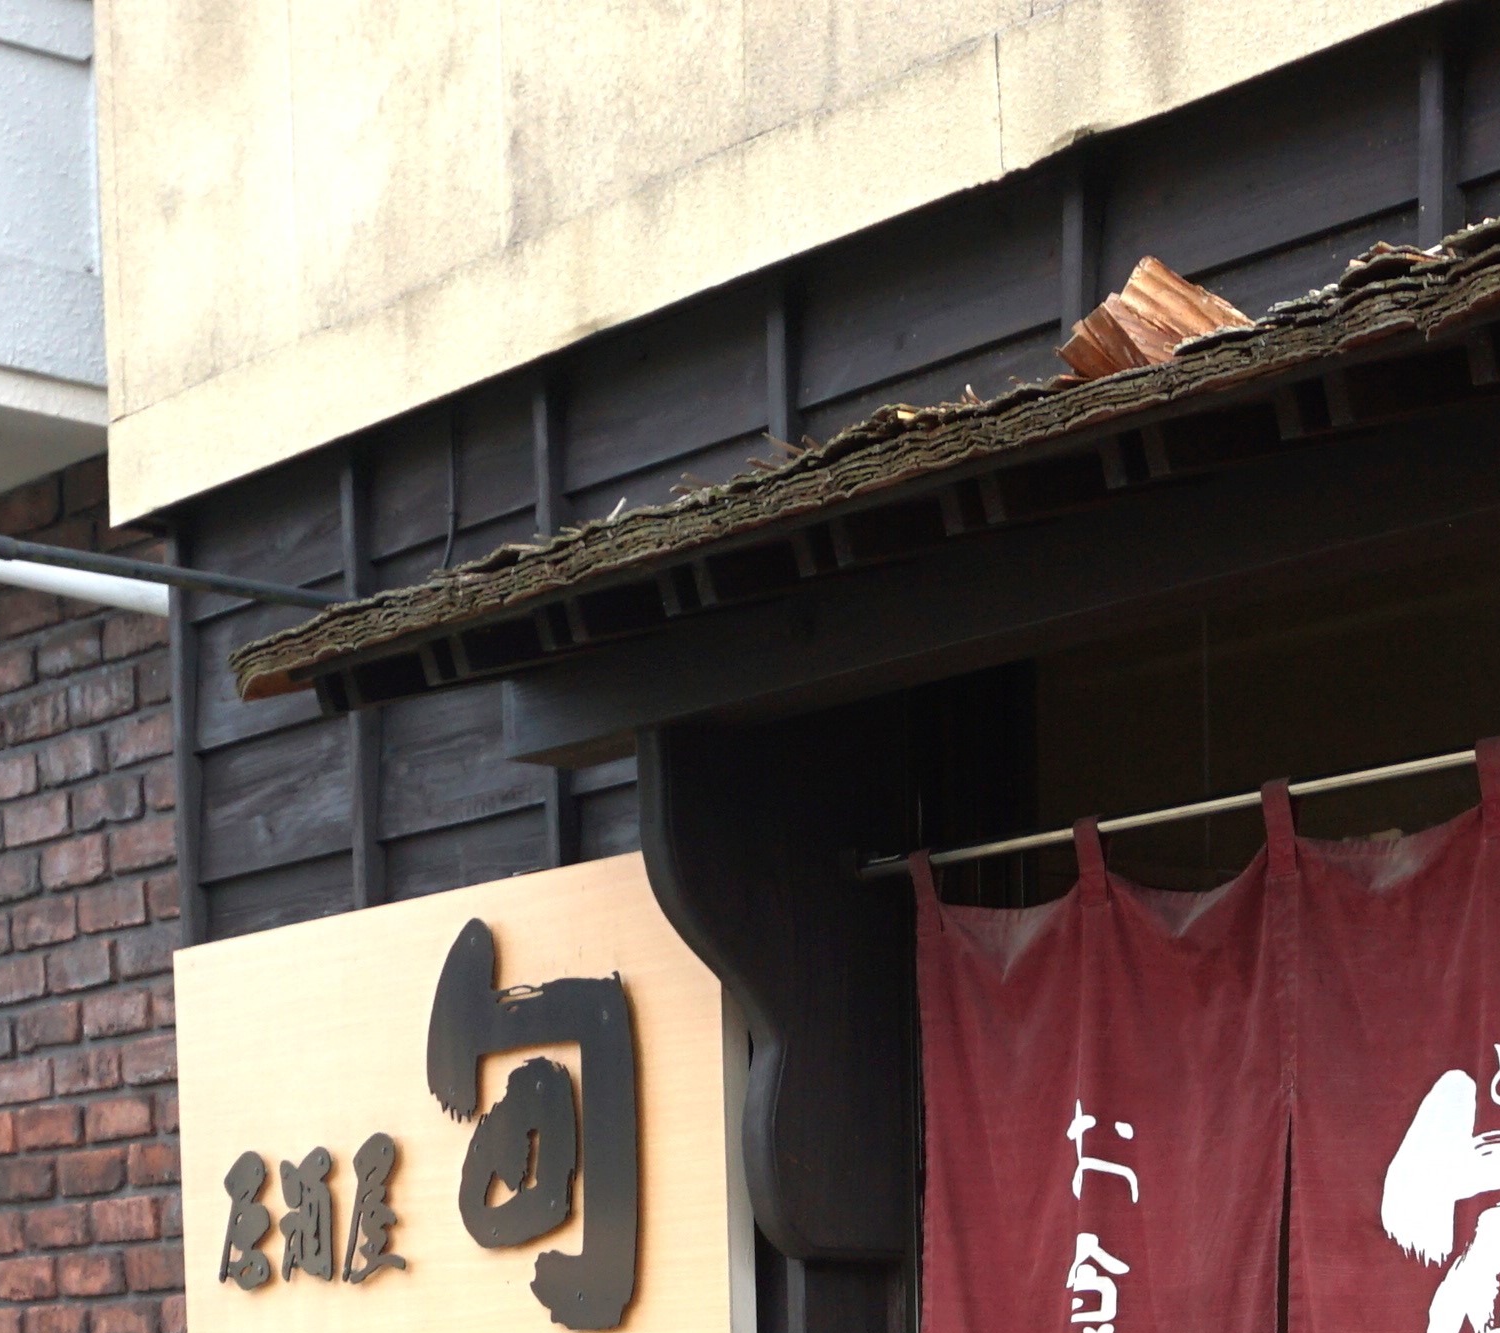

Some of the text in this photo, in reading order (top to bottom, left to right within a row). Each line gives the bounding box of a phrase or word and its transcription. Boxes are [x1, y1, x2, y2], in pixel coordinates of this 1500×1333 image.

[219, 1132, 406, 1291] 居酒屋
[427, 918, 638, 1331] 旬
